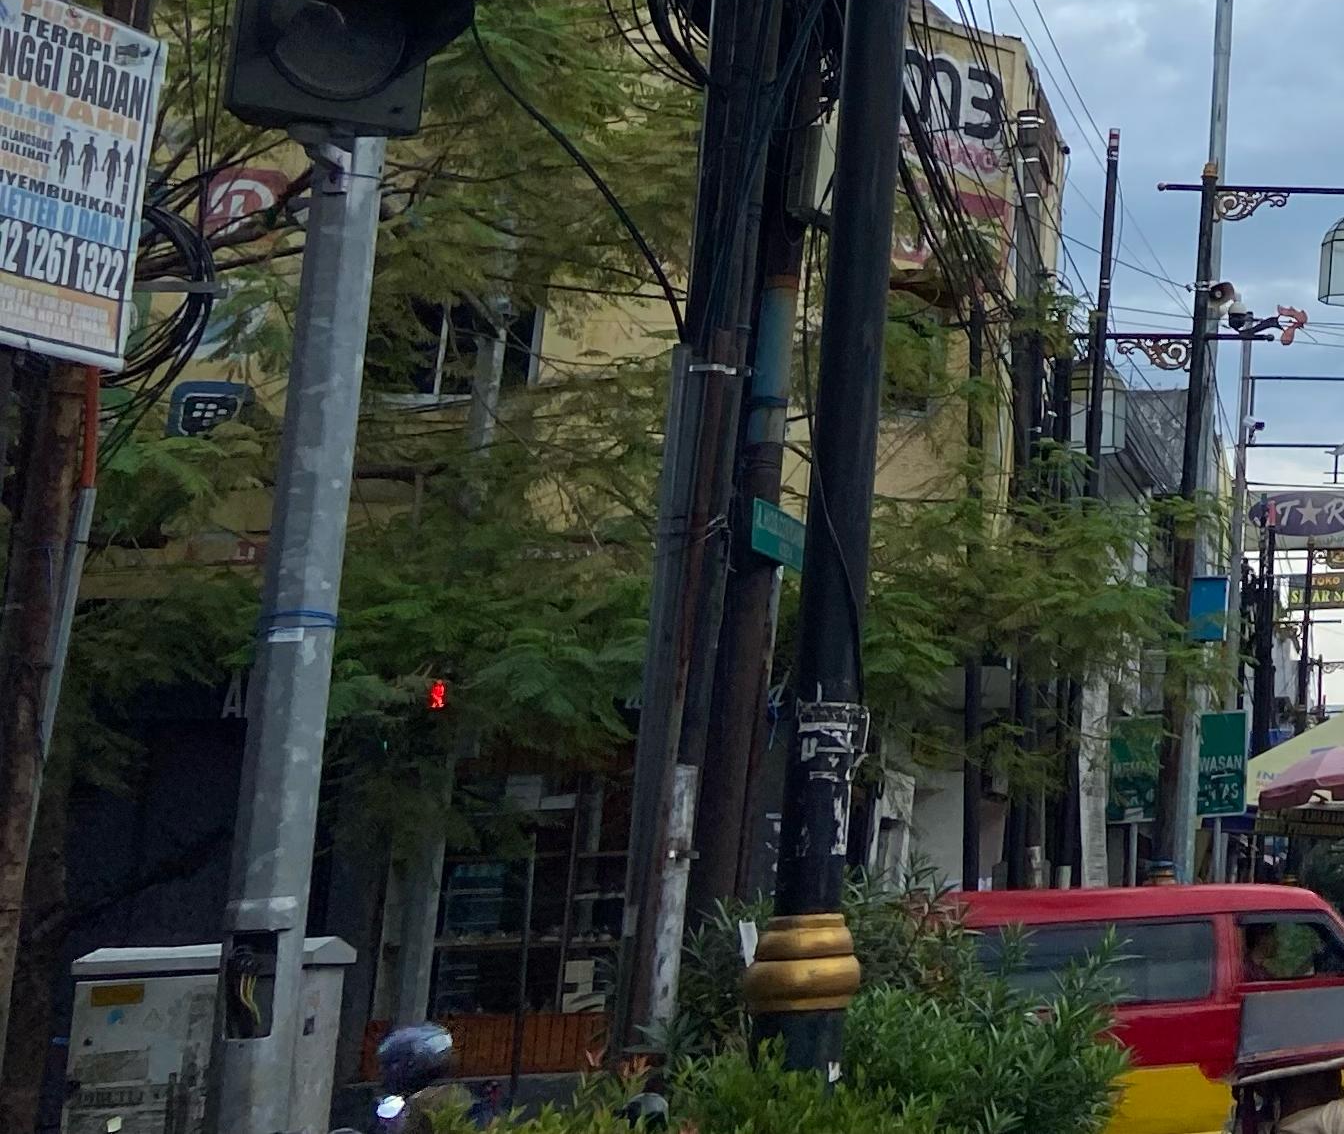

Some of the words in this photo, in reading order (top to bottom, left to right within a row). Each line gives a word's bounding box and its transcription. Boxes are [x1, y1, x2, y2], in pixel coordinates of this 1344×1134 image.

[21, 12, 112, 63] TERAPI
[0, 27, 64, 92] NGGI
[66, 52, 147, 122] BADAN
[1, 139, 50, 164] DILIHAT
[25, 226, 74, 286] 1261
[76, 240, 125, 300] 1322
[1311, 576, 1341, 587] TOKO
[1290, 588, 1331, 604] SIAR
[1200, 754, 1243, 772] WASAN
